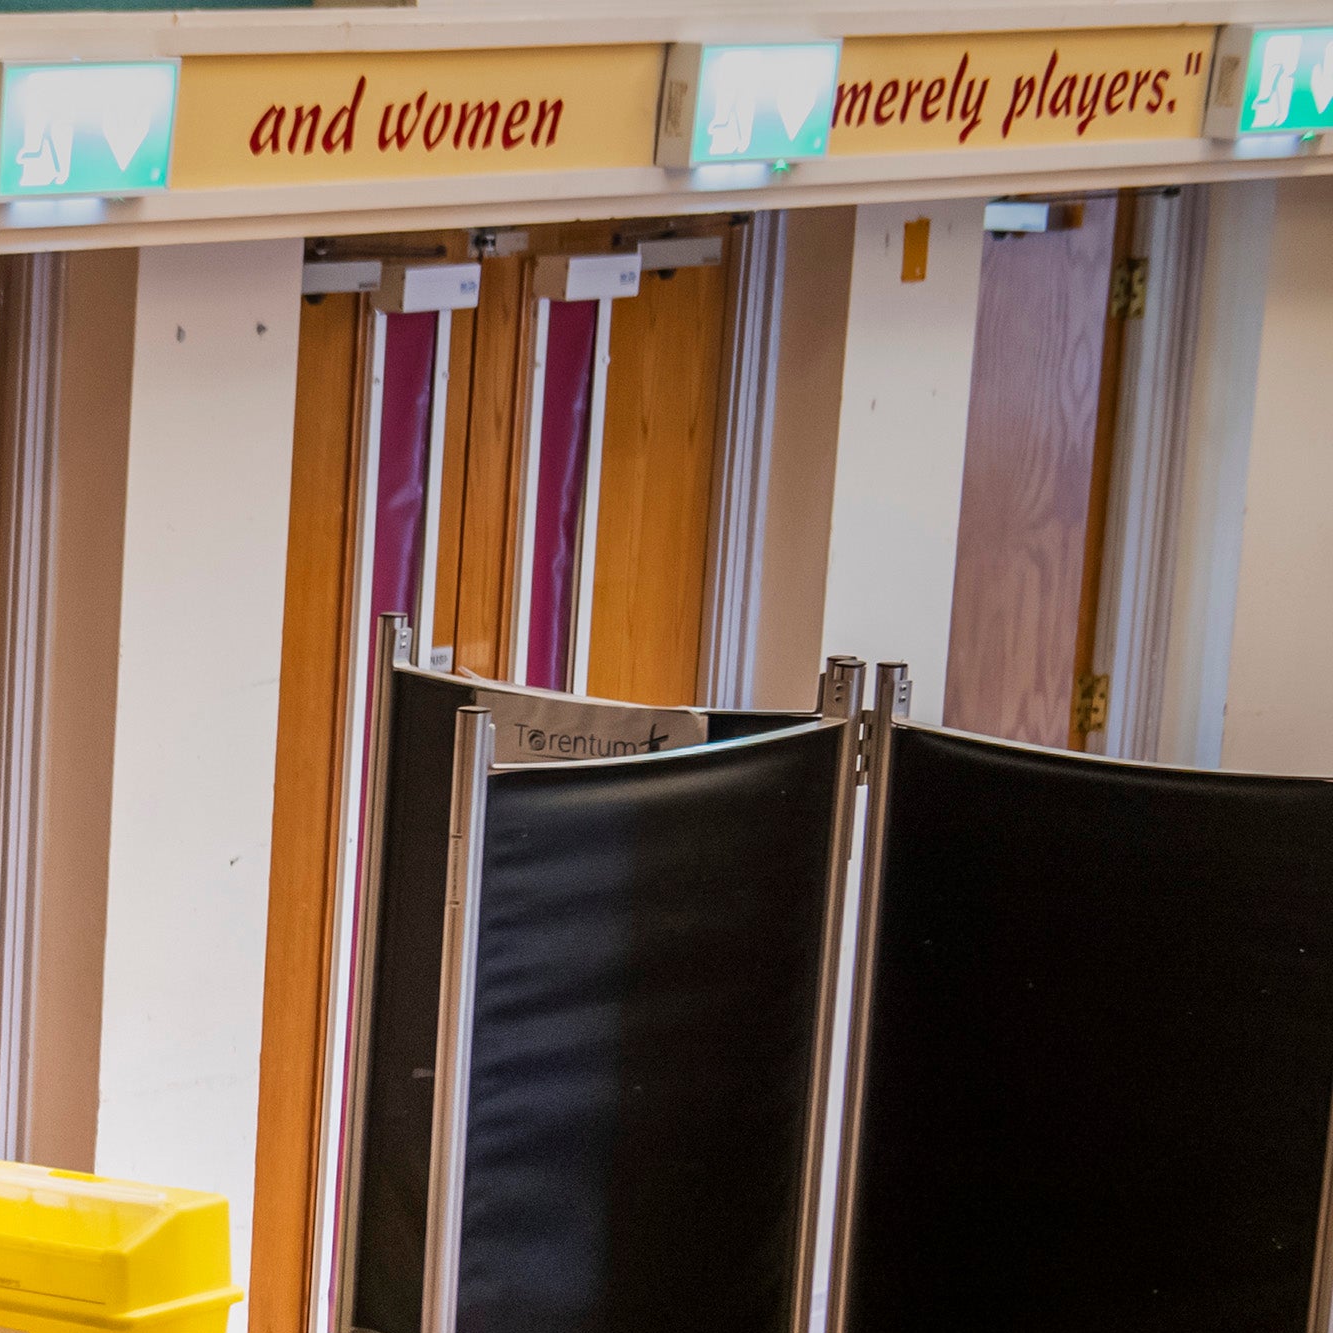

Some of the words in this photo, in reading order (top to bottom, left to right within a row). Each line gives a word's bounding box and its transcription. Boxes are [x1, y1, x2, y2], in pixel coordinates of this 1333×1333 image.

[248, 74, 367, 156] and
[376, 90, 564, 152] women
[832, 52, 990, 144] merely
[1001, 51, 1204, 139] players."
[514, 723, 637, 757] Torentum
